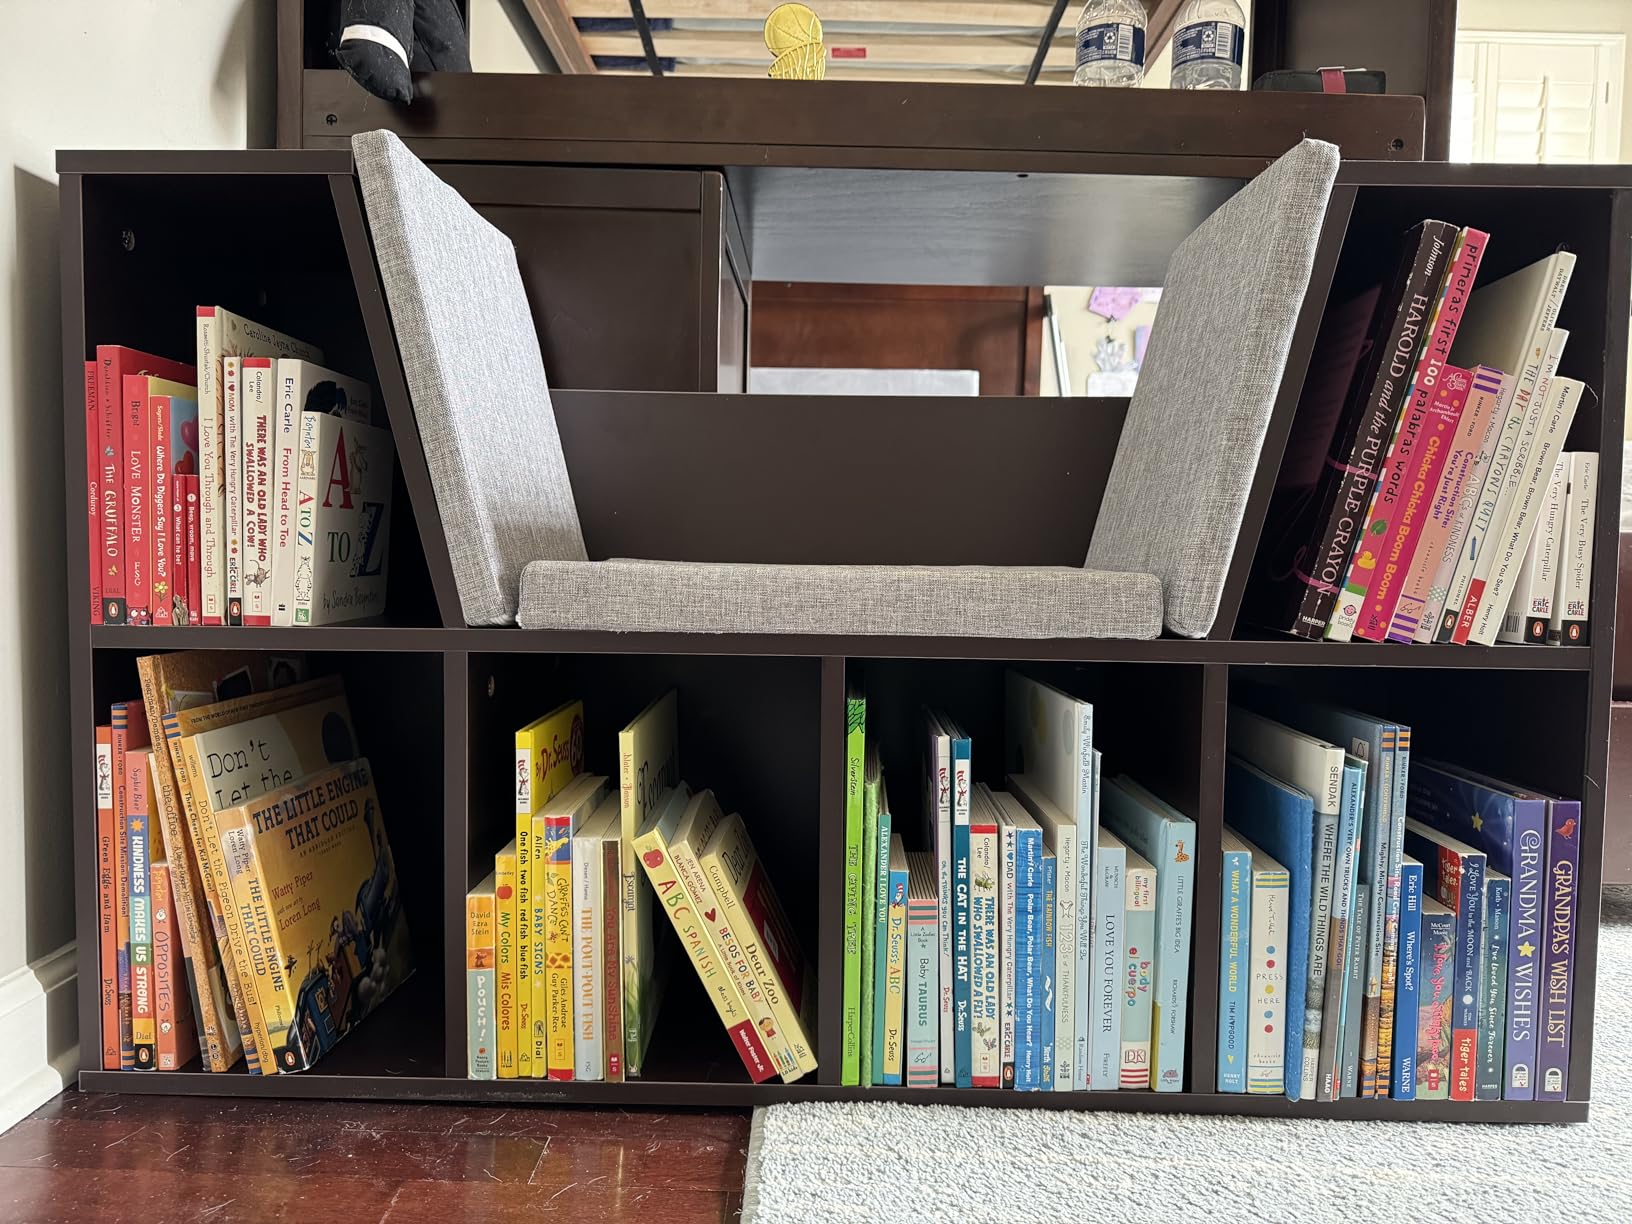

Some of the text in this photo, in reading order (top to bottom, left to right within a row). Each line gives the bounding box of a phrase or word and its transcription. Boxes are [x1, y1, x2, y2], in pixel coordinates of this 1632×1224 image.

[1424, 234, 1446, 278] Johnson
[1384, 242, 1480, 504] primeras first 100 palabras words
[284, 378, 294, 433] Eric Carle
[1549, 385, 1570, 434] Martin Carle
[322, 426, 354, 510] A
[1317, 292, 1428, 596] HAROLD and the PURPLE CRAYON
[130, 451, 142, 543] LOVE MONSTER
[246, 442, 255, 504] SWALLOWED
[257, 415, 267, 562] THERE WAS AN OLD LADY WHO
[279, 448, 292, 548] From Head to Toe
[89, 482, 98, 516] Corduroy
[105, 465, 118, 557] THE GRUFFALO
[1377, 436, 1440, 599] Chicka Chicka Boom Boom
[1541, 462, 1564, 582] The Very Hungry Caterpillar
[246, 521, 255, 548] COW!
[327, 531, 350, 563] TO
[1302, 615, 1326, 627] HARPER
[1461, 595, 1478, 628] ALBER
[207, 738, 271, 779] Don't
[850, 757, 860, 796] Silverstein
[252, 767, 369, 834] THE LITTLE ENGINE
[1328, 766, 1338, 808] SENDAK
[285, 816, 321, 850] THAT
[321, 801, 358, 832] COULD
[132, 836, 144, 893] KINDNESS
[1063, 838, 1071, 867] Hegarty
[272, 871, 314, 901] Watty Piper
[709, 865, 735, 909] Campbell
[1314, 824, 1334, 976] WHERE THE WILD THINGS ARE
[1408, 875, 1418, 911] Eric Hill
[134, 898, 146, 943] MAKES
[248, 877, 259, 900] THE
[255, 901, 273, 944] LITTLE
[265, 946, 284, 993] ENGINE
[279, 898, 321, 931] Loren Long
[470, 911, 491, 919] David
[471, 928, 490, 936] Stein
[473, 920, 488, 928] Ezra
[957, 857, 967, 982] THE CAT IN THE HAT
[1512, 829, 1542, 1042] GRANDMA WISHES
[135, 947, 146, 962] US
[240, 904, 267, 976] THAT COULD
[534, 908, 544, 975] BABY SIGNS
[719, 926, 764, 1003] BESOS FOR BABY
[889, 917, 902, 994] Dr. Seuss's ABC
[973, 896, 984, 1019] WHO SWALLOWED A FLY!
[984, 896, 995, 1020] THERE WAS AN OLD LADY
[1404, 931, 1416, 991] Where's Spot?
[1547, 860, 1574, 1048] GRANDPA'S WISH LIST
[154, 932, 171, 1012] OPPOSITES
[499, 912, 512, 1031] My Colors Mis Colores
[551, 973, 559, 985] Guy
[745, 942, 779, 1005] Dear Zoo
[919, 958, 929, 1027] Baby TAURUS
[1102, 914, 1115, 1032] LOVE YOU FOREVER
[1125, 947, 1140, 1006] el cuerpo
[1137, 961, 1150, 992] body
[1256, 973, 1284, 981] PRESS
[560, 978, 568, 1028] Giles Andreae
[535, 1041, 543, 1059] Dial
[847, 1007, 855, 1057] HarperCollins
[888, 1029, 897, 1062] Dr. Seuss
[1125, 1050, 1146, 1063] DK
[1460, 1037, 1472, 1060] tiger
[1401, 1057, 1412, 1094] WARNE
[1458, 1063, 1470, 1092] tales
